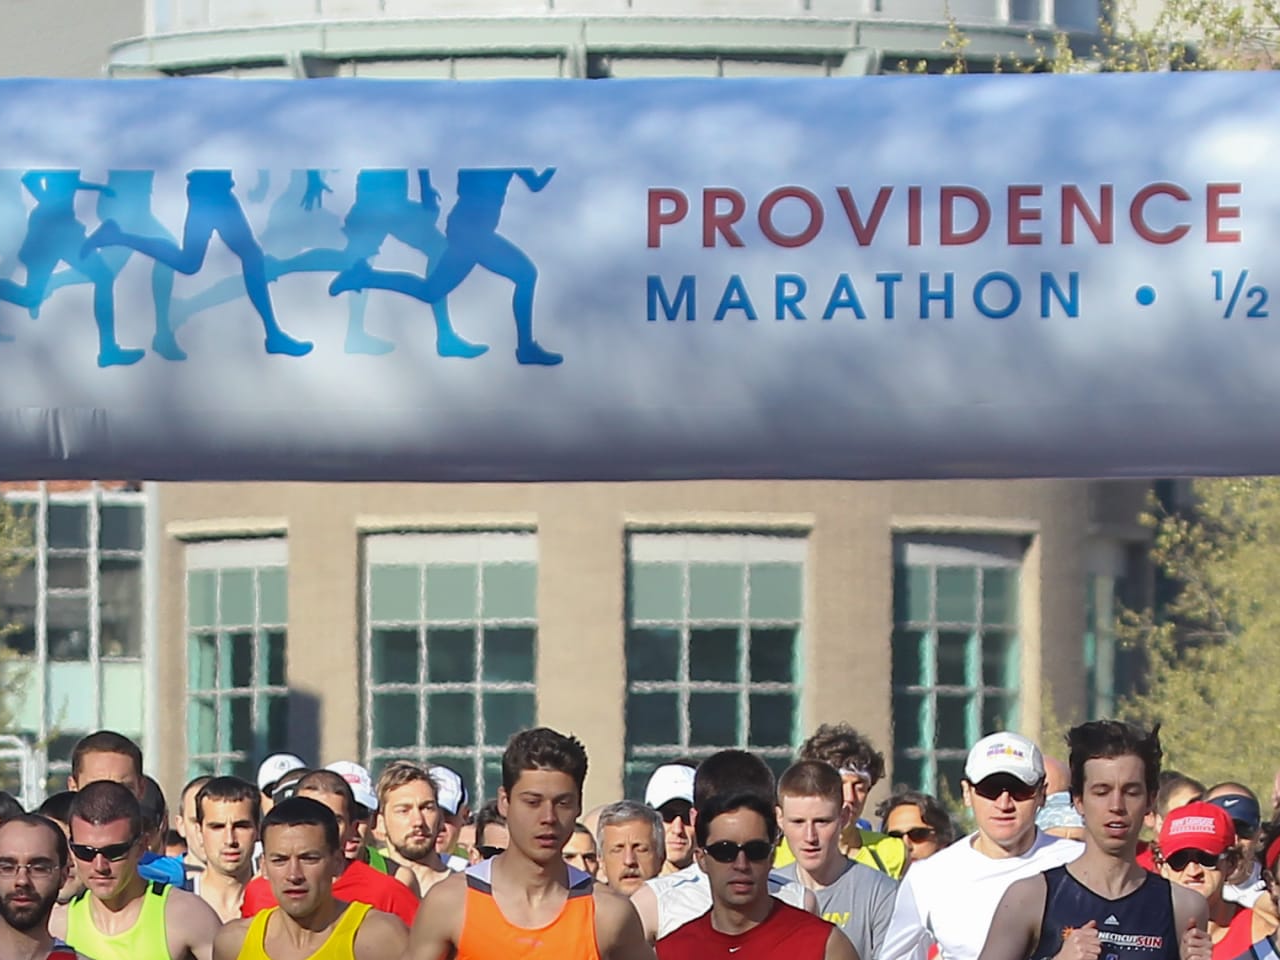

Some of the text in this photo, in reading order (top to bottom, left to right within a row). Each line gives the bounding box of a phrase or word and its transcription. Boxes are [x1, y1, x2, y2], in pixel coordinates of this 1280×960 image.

[648, 182, 1241, 248] PROVIDENCE
[647, 271, 1079, 321] MARATHON
[1137, 936, 1163, 949] SUN
